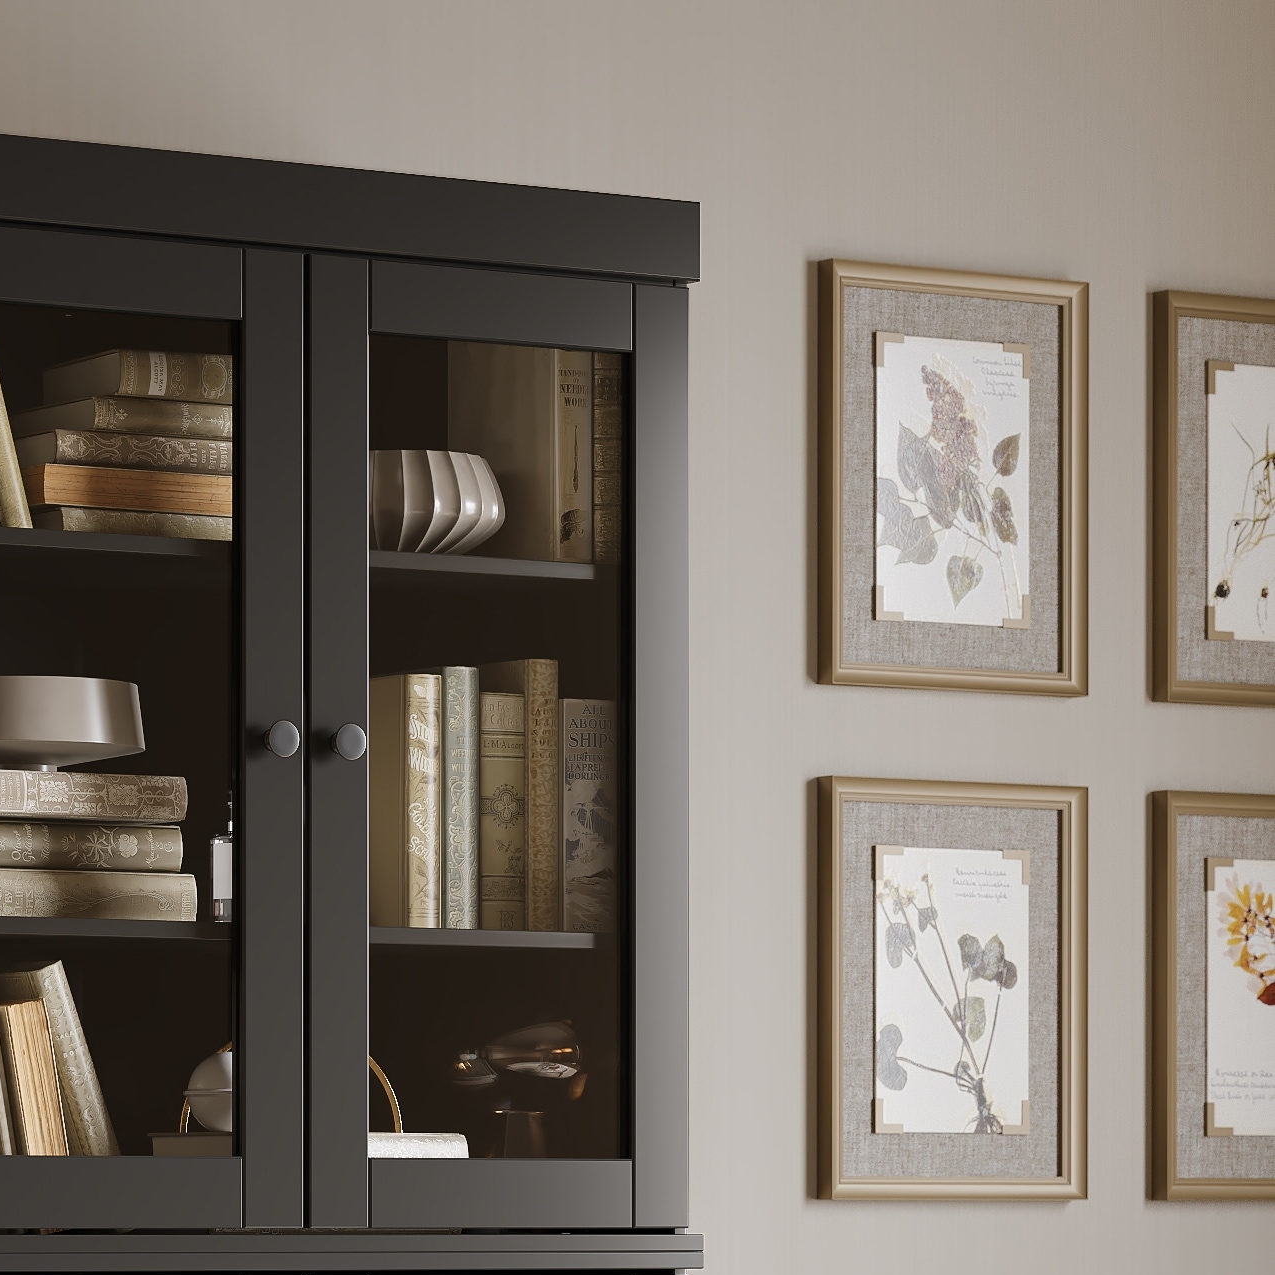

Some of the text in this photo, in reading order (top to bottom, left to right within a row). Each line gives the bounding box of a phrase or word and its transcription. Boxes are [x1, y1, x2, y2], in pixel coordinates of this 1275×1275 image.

[564, 396, 587, 408] WORK
[581, 704, 606, 716] ALL
[568, 718, 612, 730] ABOUT
[568, 732, 615, 748] SHIPS
[11, 830, 22, 861] Oliver
[4, 890, 12, 903] BY
